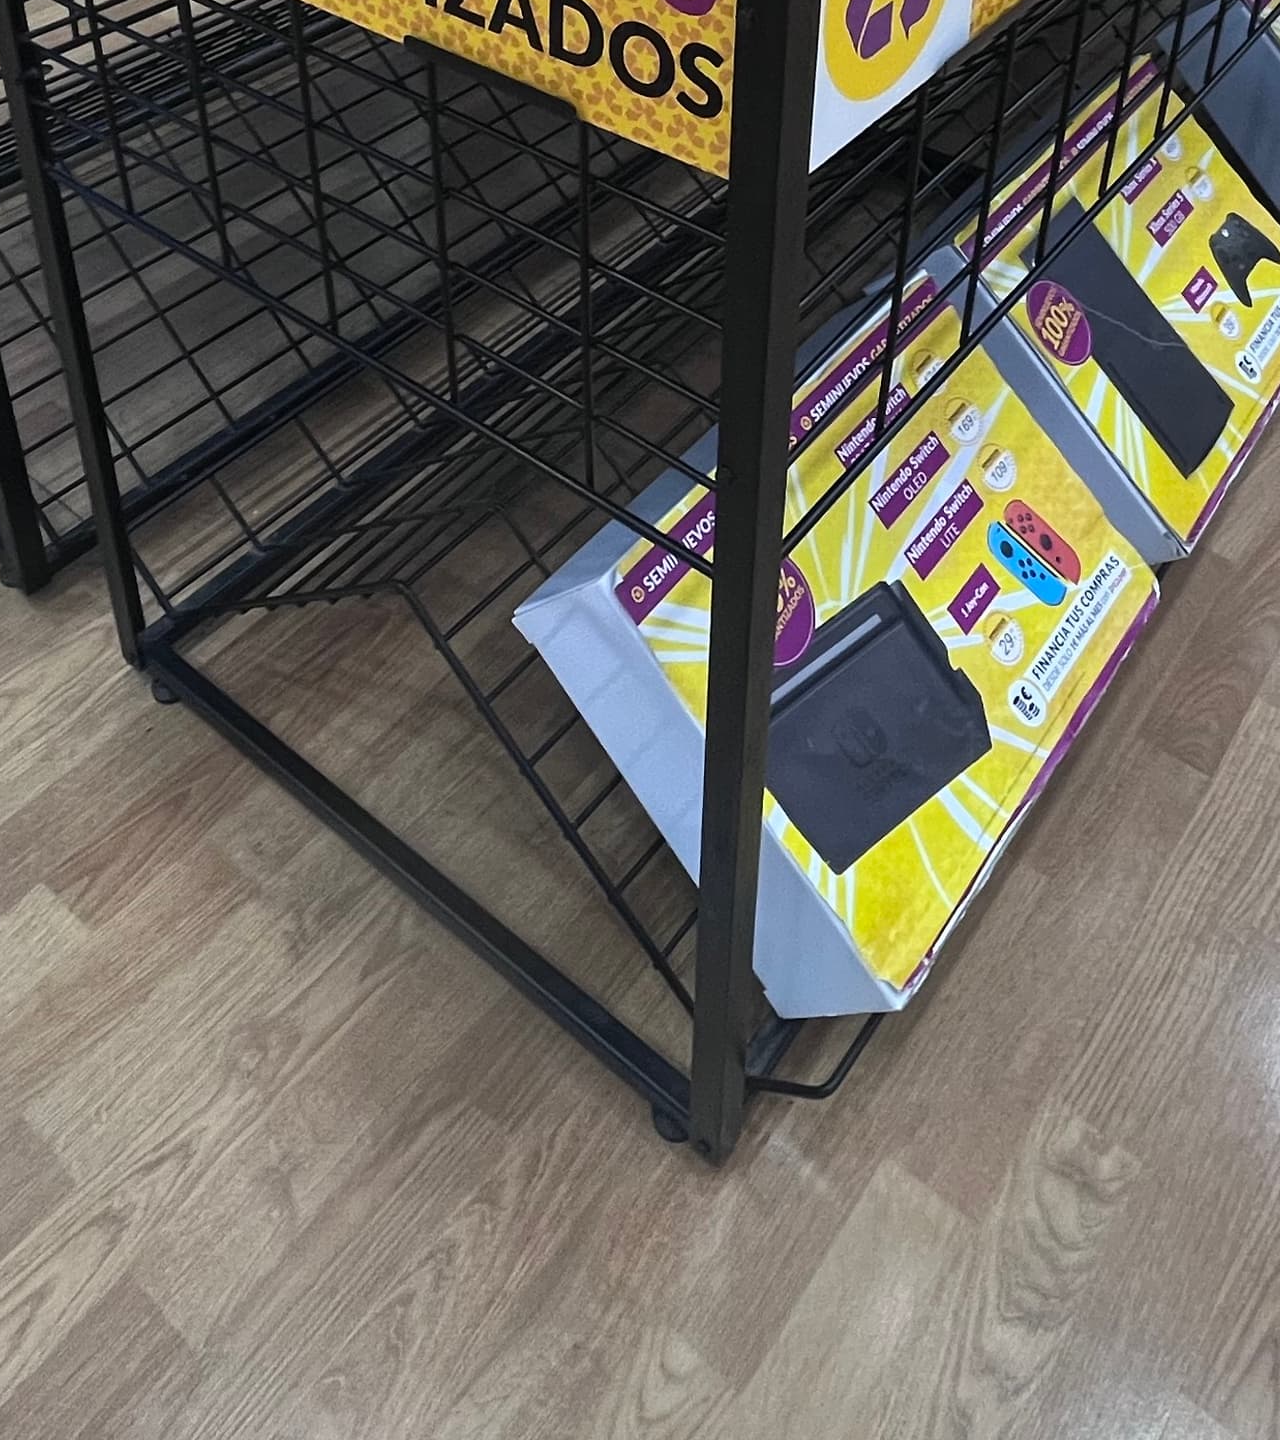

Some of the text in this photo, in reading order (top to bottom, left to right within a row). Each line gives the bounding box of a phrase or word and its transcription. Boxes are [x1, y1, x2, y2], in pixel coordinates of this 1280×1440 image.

[1041, 297, 1077, 351] 100%
[870, 434, 940, 513] Nintendo Switch
[903, 470, 929, 501] OLED
[905, 483, 974, 563] Nintendo Switch
[940, 522, 961, 550] LITE
[1031, 555, 1120, 681] FINANCIA TUS COMPRAS
